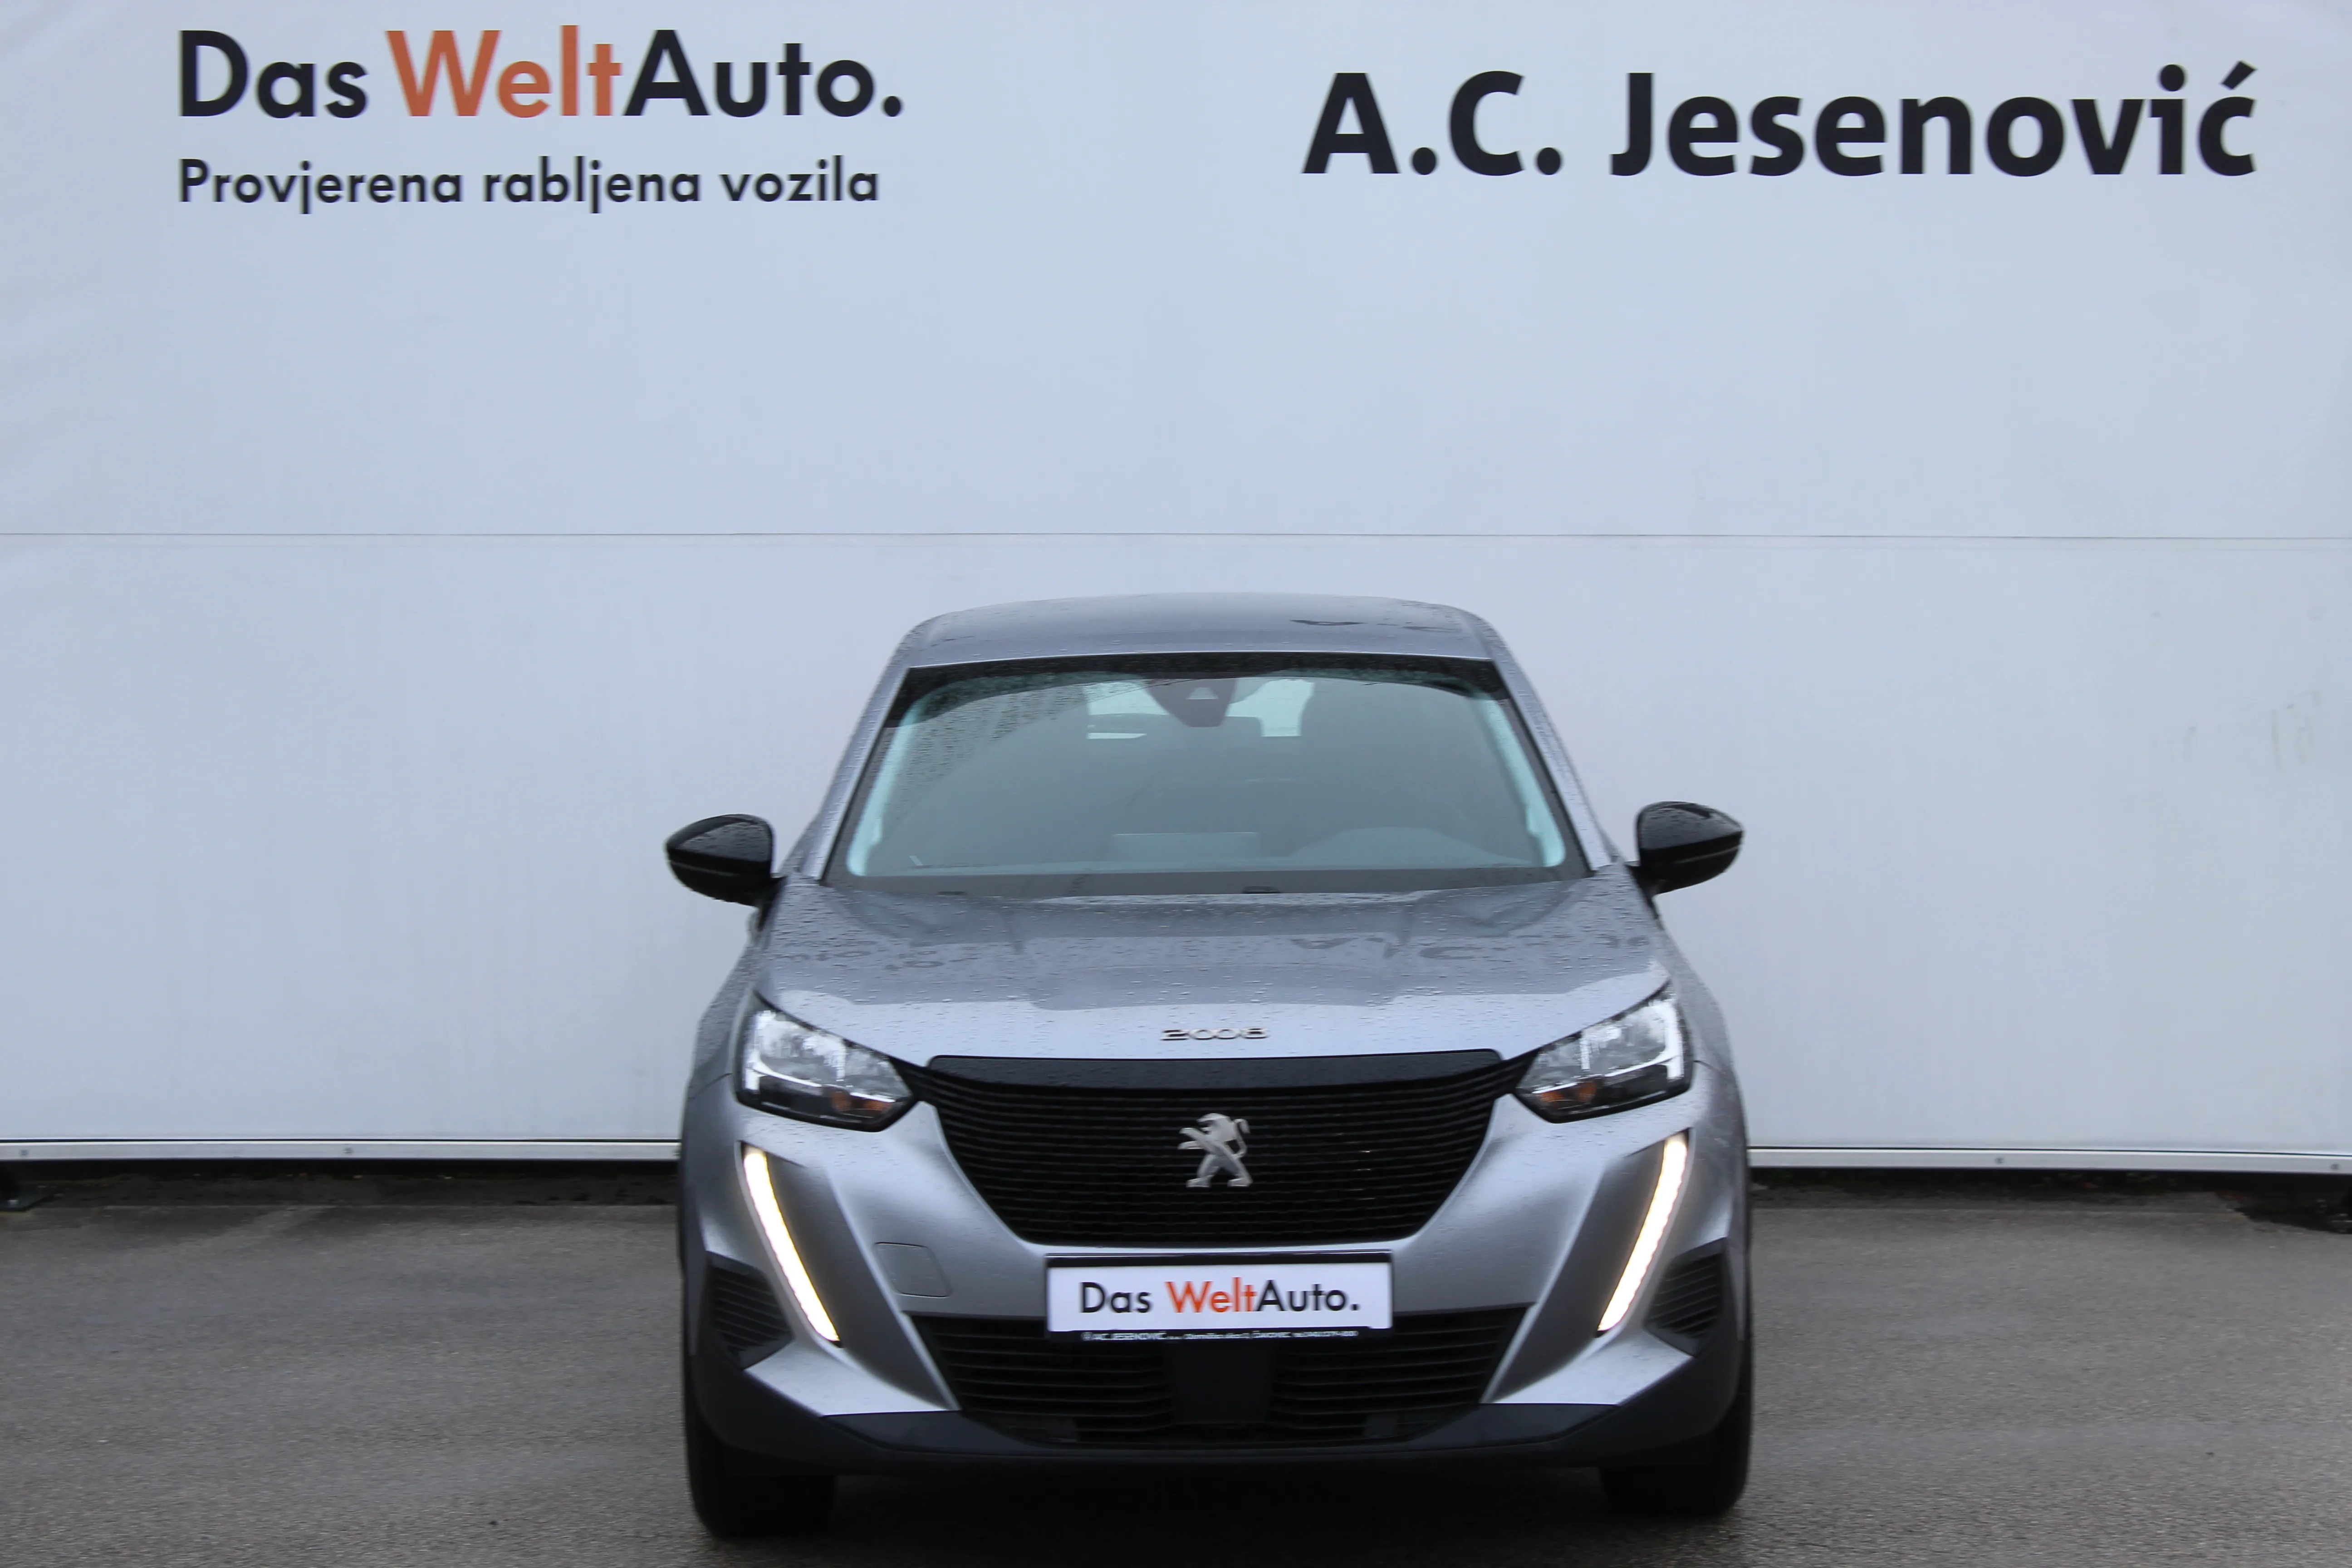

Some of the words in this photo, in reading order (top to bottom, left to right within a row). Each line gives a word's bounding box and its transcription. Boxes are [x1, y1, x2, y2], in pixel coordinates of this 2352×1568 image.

[180, 30, 366, 118] Das
[386, 25, 902, 118] WeltAuto.
[1302, 70, 1562, 176] A.C.
[1611, 61, 2256, 177] Jesenović
[180, 158, 461, 215] Provjerena
[485, 156, 699, 214] rabljena
[720, 155, 877, 202] vozila
[1160, 1026, 1270, 1041] 2008
[1081, 1281, 1151, 1313] Das
[1166, 1277, 1358, 1313] WeltAuto.
